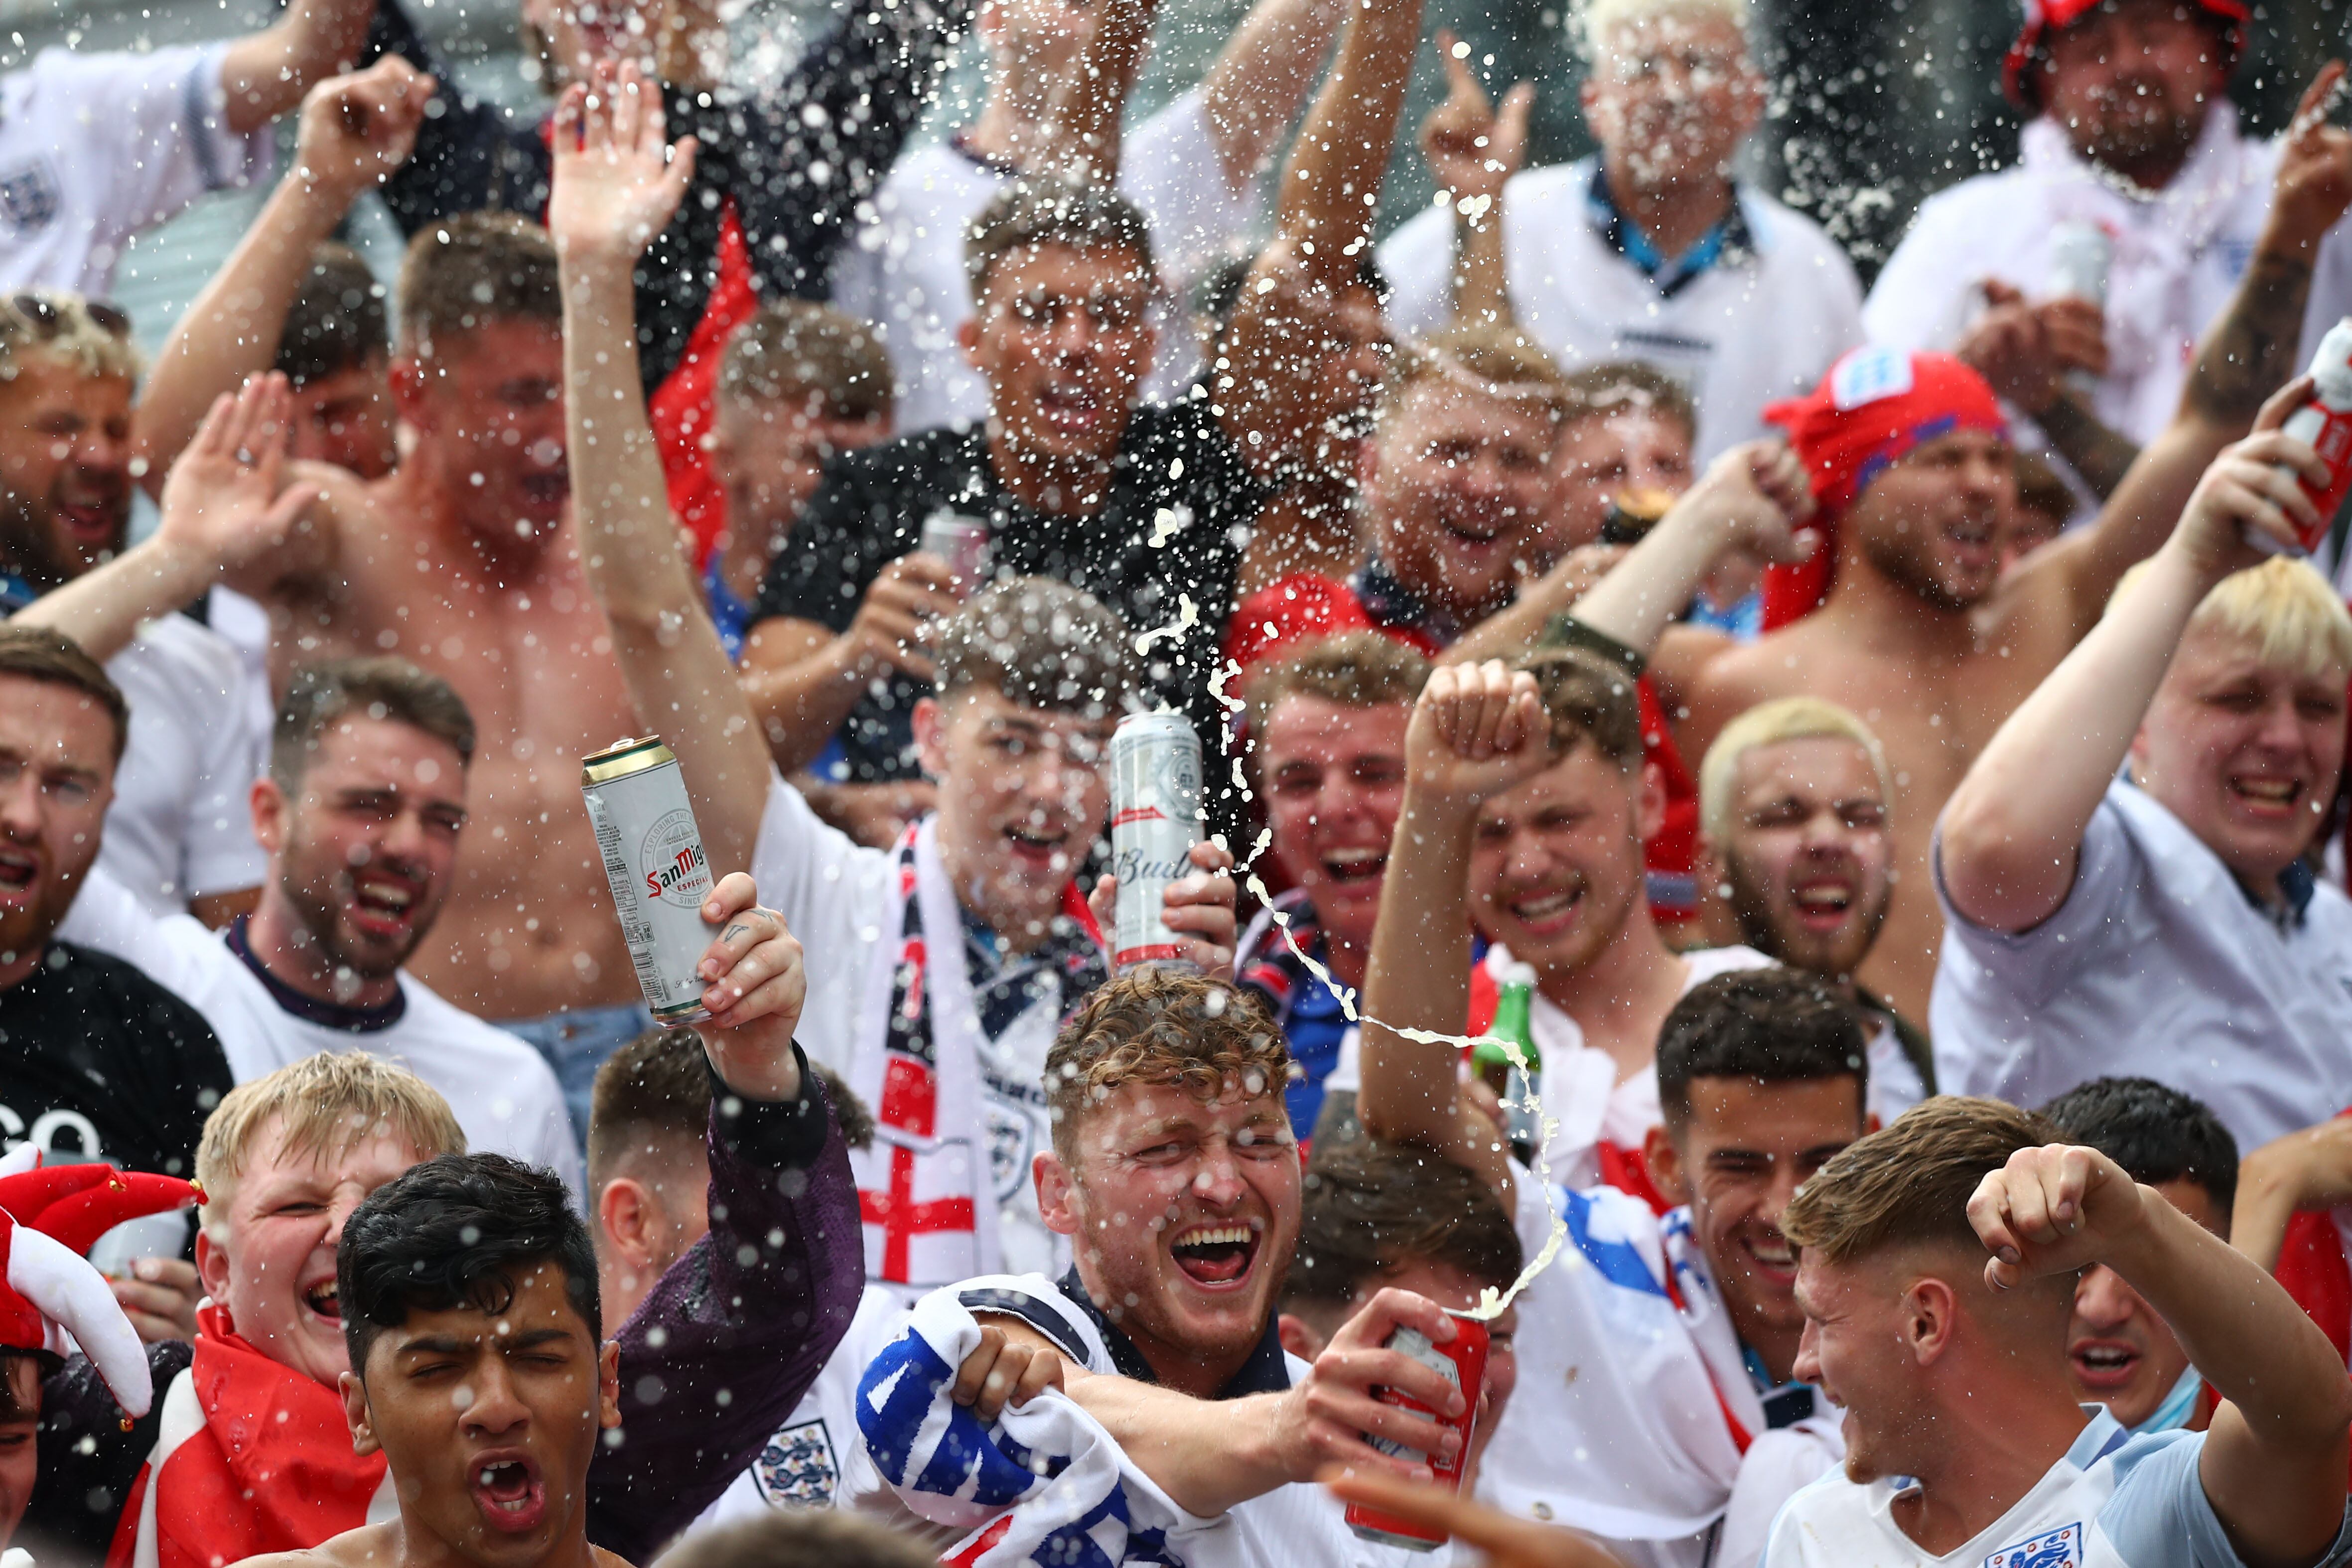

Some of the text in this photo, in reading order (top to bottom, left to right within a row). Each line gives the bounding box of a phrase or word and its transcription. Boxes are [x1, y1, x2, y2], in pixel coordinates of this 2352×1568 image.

[645, 815, 675, 854] EXPLORING
[677, 877, 708, 892] ESPECIAL
[679, 896, 701, 905] SINCE
